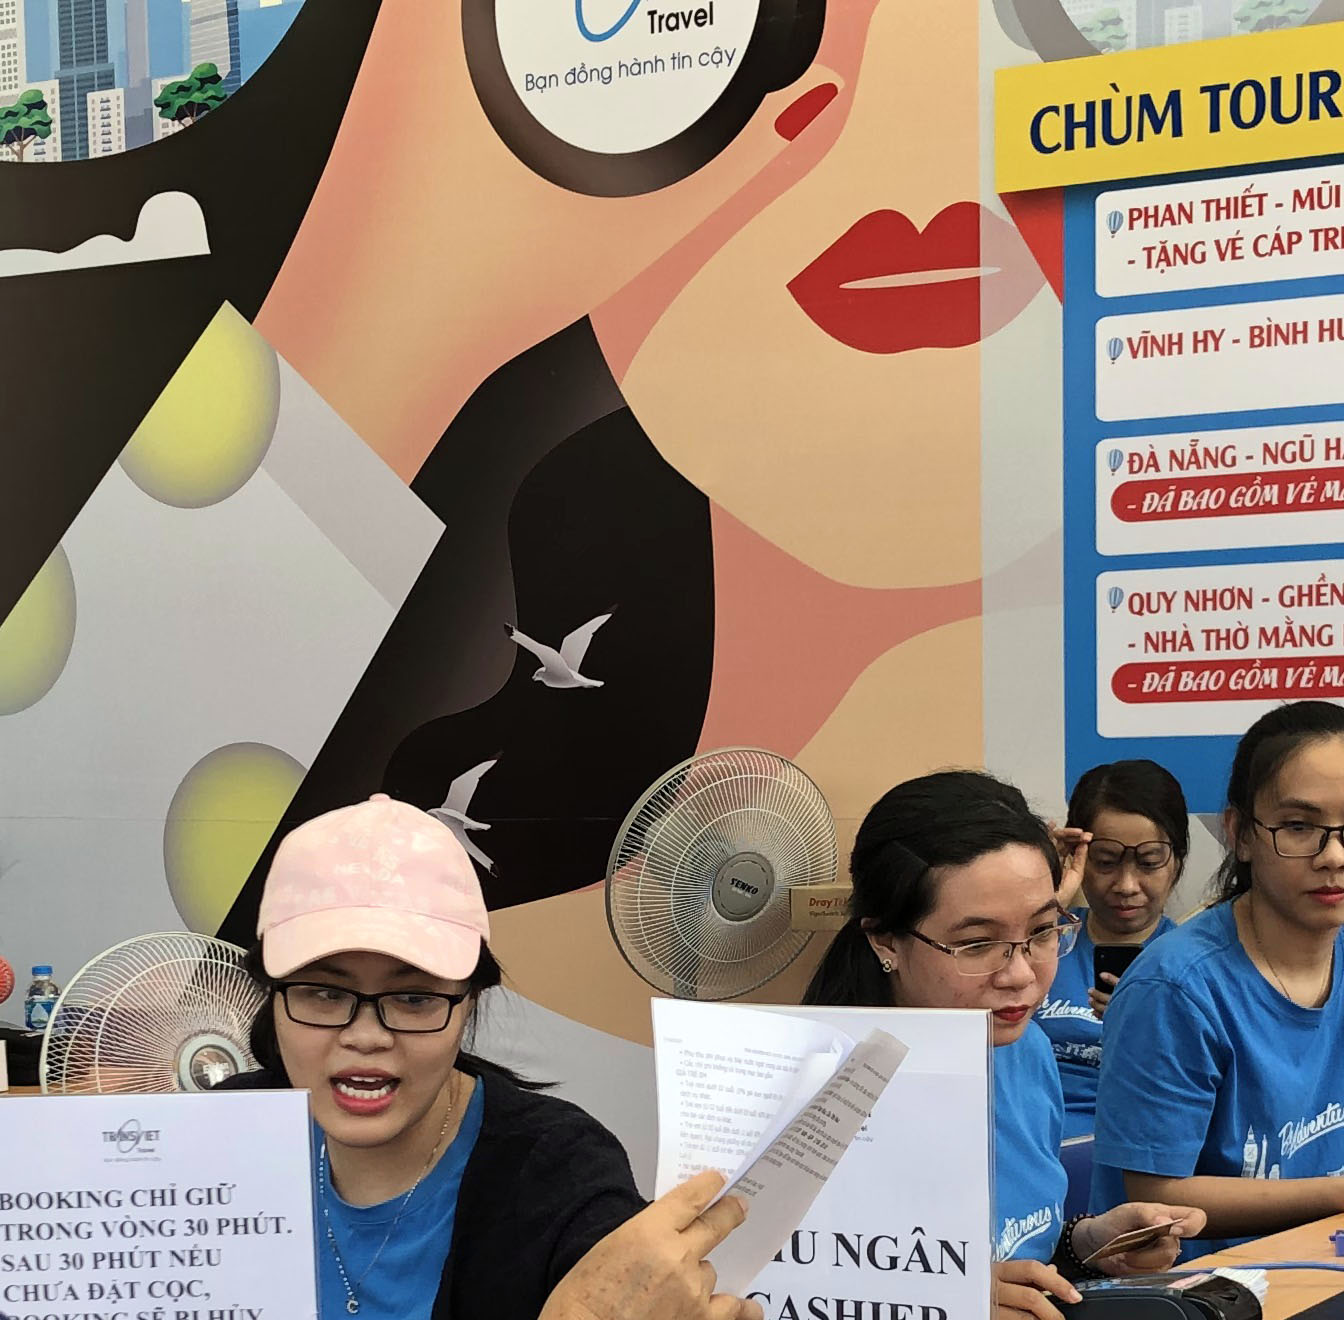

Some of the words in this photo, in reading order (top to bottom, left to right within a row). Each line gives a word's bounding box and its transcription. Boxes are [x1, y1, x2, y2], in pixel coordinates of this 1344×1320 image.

[648, 1, 714, 34] Travel
[526, 74, 558, 92] Bạn
[565, 63, 612, 85] đồng
[619, 56, 664, 78] hành
[671, 52, 692, 70] tin
[699, 46, 738, 70] cậy
[1030, 83, 1182, 154] CHÙM
[1200, 70, 1342, 133] TOUR
[1129, 201, 1193, 230] PHAN
[1201, 184, 1268, 222] THIẾT
[1292, 181, 1340, 212] MŨI
[1127, 444, 1160, 474] ĐÀ
[1170, 439, 1236, 472] NẴNG
[1263, 434, 1314, 465] NGŨ
[730, 877, 759, 895] SENKO
[0, 1190, 122, 1210] BOOKING
[130, 1183, 176, 1207] CHỈ
[186, 1183, 236, 1205] GIỮ
[0, 1222, 92, 1241] TRONG
[101, 1215, 175, 1238] VÒNG
[184, 1219, 208, 1236] 30
[217, 1211, 292, 1235] PHÚT.
[2, 1254, 47, 1271] SAU
[60, 1253, 83, 1270] 30
[93, 1247, 161, 1269] PHÚT
[170, 1244, 220, 1267] NẾU
[832, 1227, 968, 1276] NGÂN
[4, 1281, 79, 1302] CHƯA
[88, 1282, 140, 1304] ĐẶT
[148, 1280, 210, 1302] CỌC,
